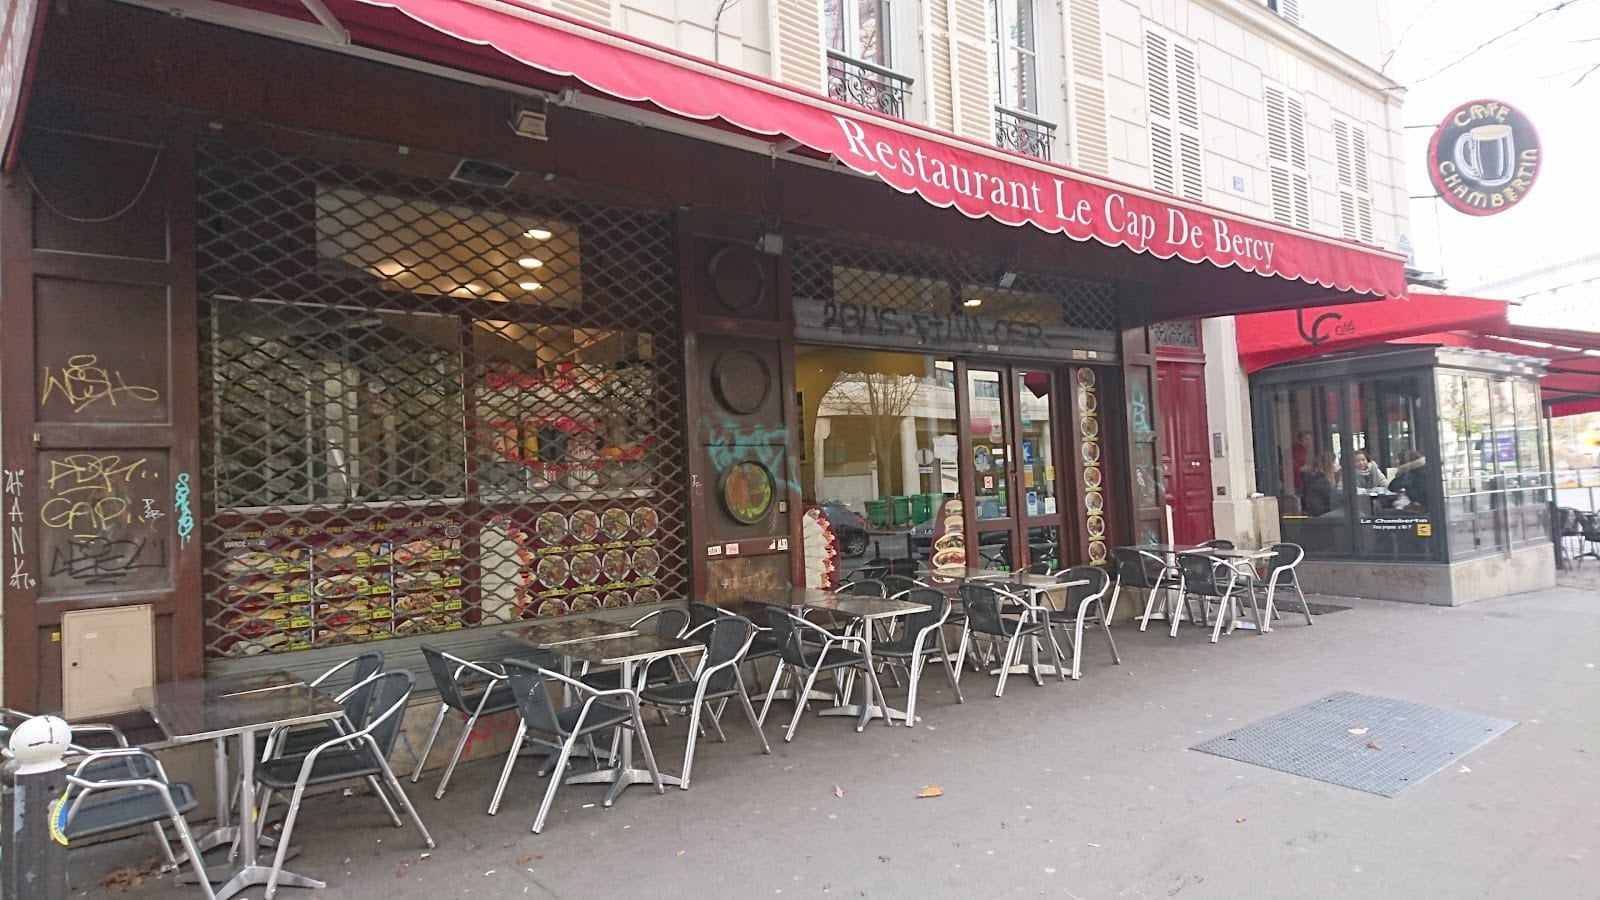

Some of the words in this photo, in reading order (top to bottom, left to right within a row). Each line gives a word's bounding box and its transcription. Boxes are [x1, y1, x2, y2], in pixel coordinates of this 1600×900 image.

[832, 114, 1044, 214] Restaurant
[1053, 178, 1092, 226] Le
[1105, 193, 1156, 248] Cap
[1167, 208, 1204, 249] De
[1213, 218, 1275, 269] Bercy
